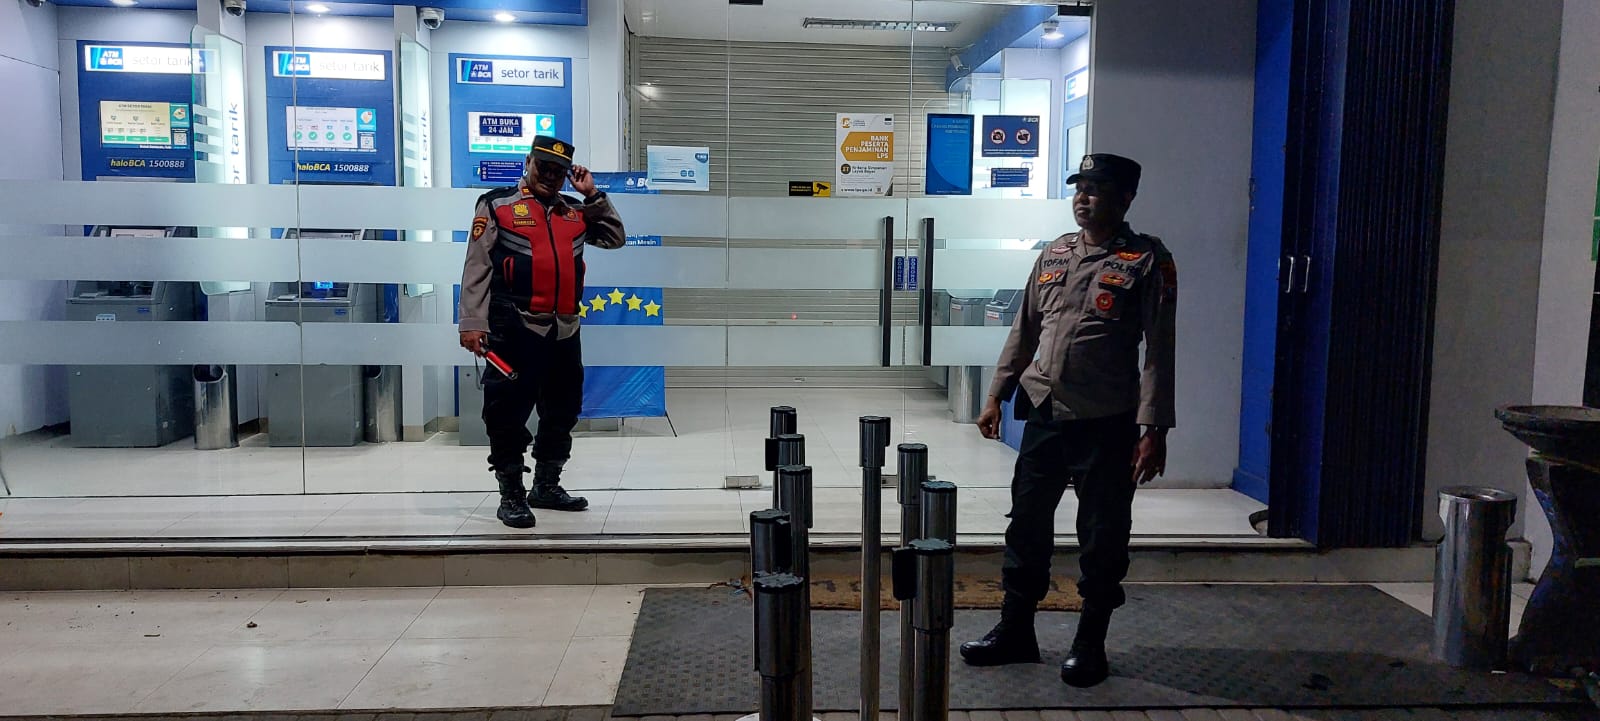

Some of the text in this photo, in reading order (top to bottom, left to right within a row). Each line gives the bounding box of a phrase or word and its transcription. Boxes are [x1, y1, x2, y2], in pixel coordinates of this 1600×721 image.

[132, 54, 192, 67] setor tarik
[353, 61, 380, 72] tarik
[472, 63, 489, 71] ATM
[501, 67, 560, 80] setor tarik
[482, 117, 519, 126] ATM BUKA
[499, 126, 514, 134] JAM
[110, 158, 185, 168] haloBCA 1500888
[296, 163, 370, 172] haloBCA 1500888
[1043, 258, 1070, 268] TOFAN
